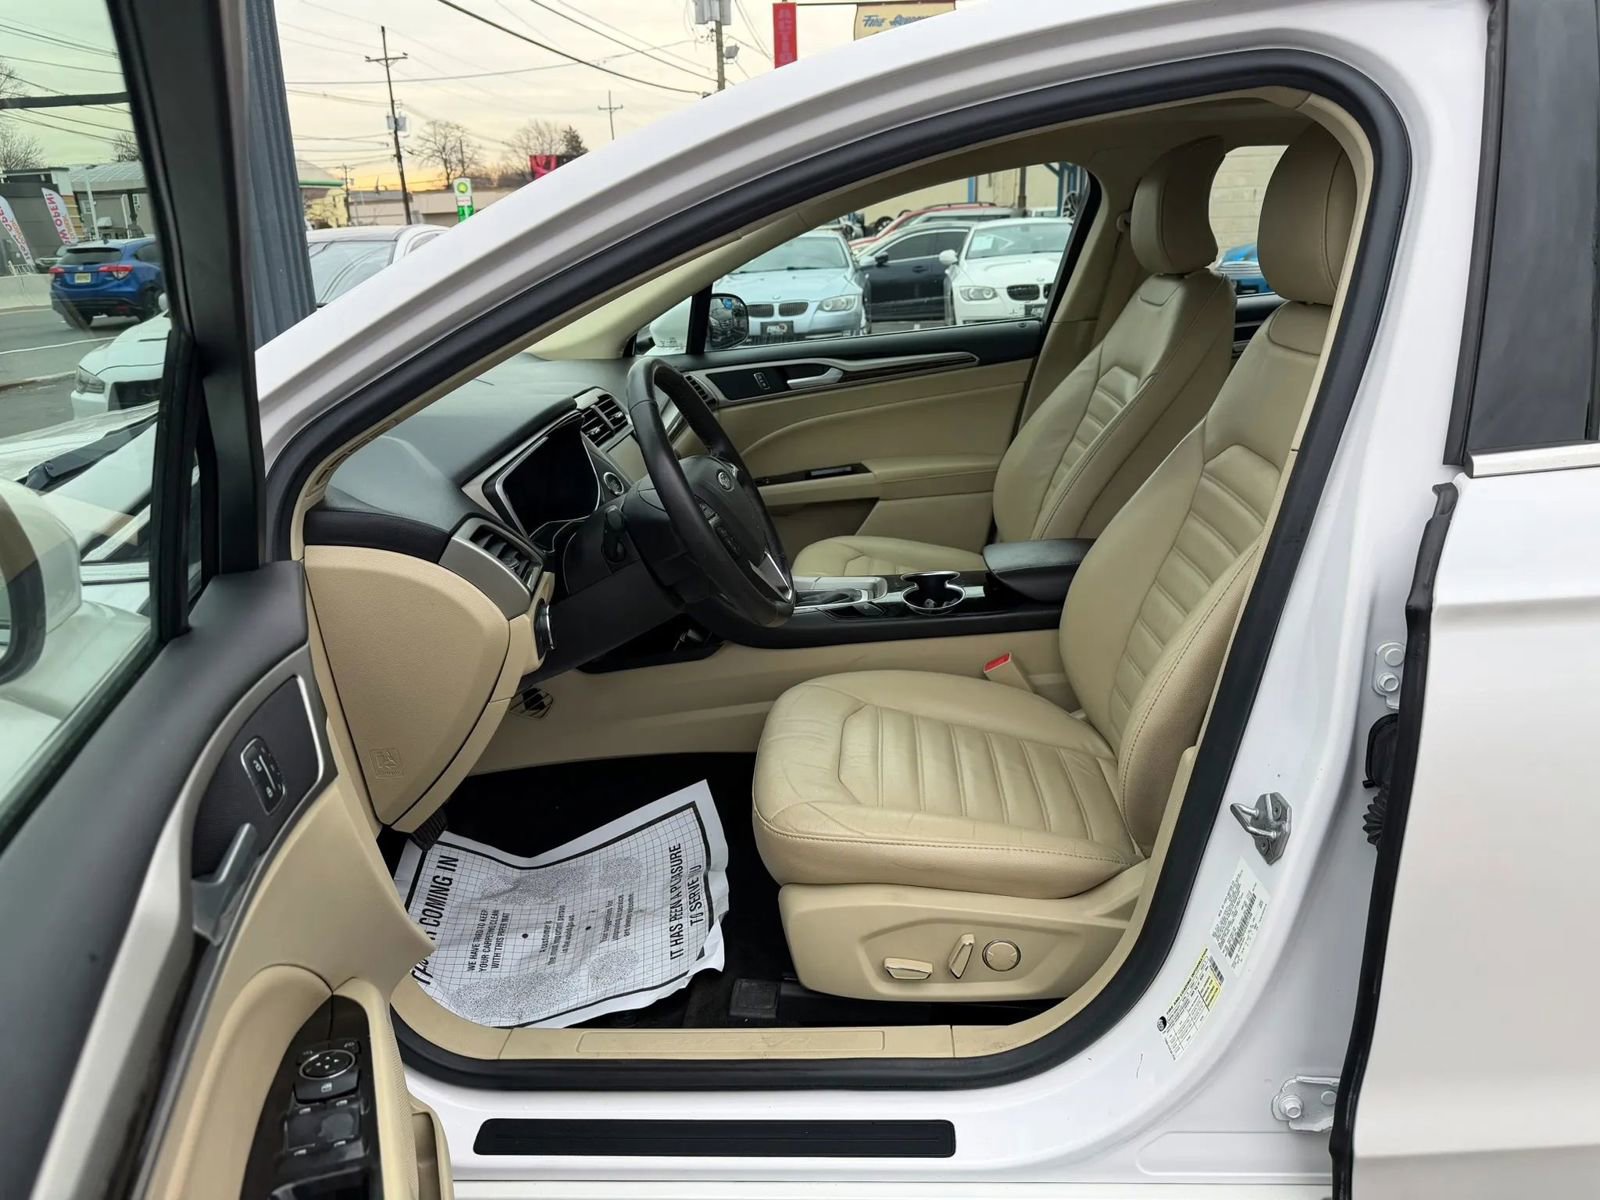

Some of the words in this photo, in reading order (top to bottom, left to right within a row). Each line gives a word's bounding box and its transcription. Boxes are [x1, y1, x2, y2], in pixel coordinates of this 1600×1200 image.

[419, 875, 453, 927] COMING
[436, 855, 460, 872] IN
[688, 877, 703, 911] SERVE
[690, 911, 704, 926] TO
[669, 923, 684, 947] HAS
[470, 943, 480, 960] HAVE
[495, 937, 505, 951] THIS
[491, 953, 501, 969] WITH
[670, 948, 684, 960] IT
[467, 961, 477, 971] WE
[478, 954, 490, 972] YOUR
